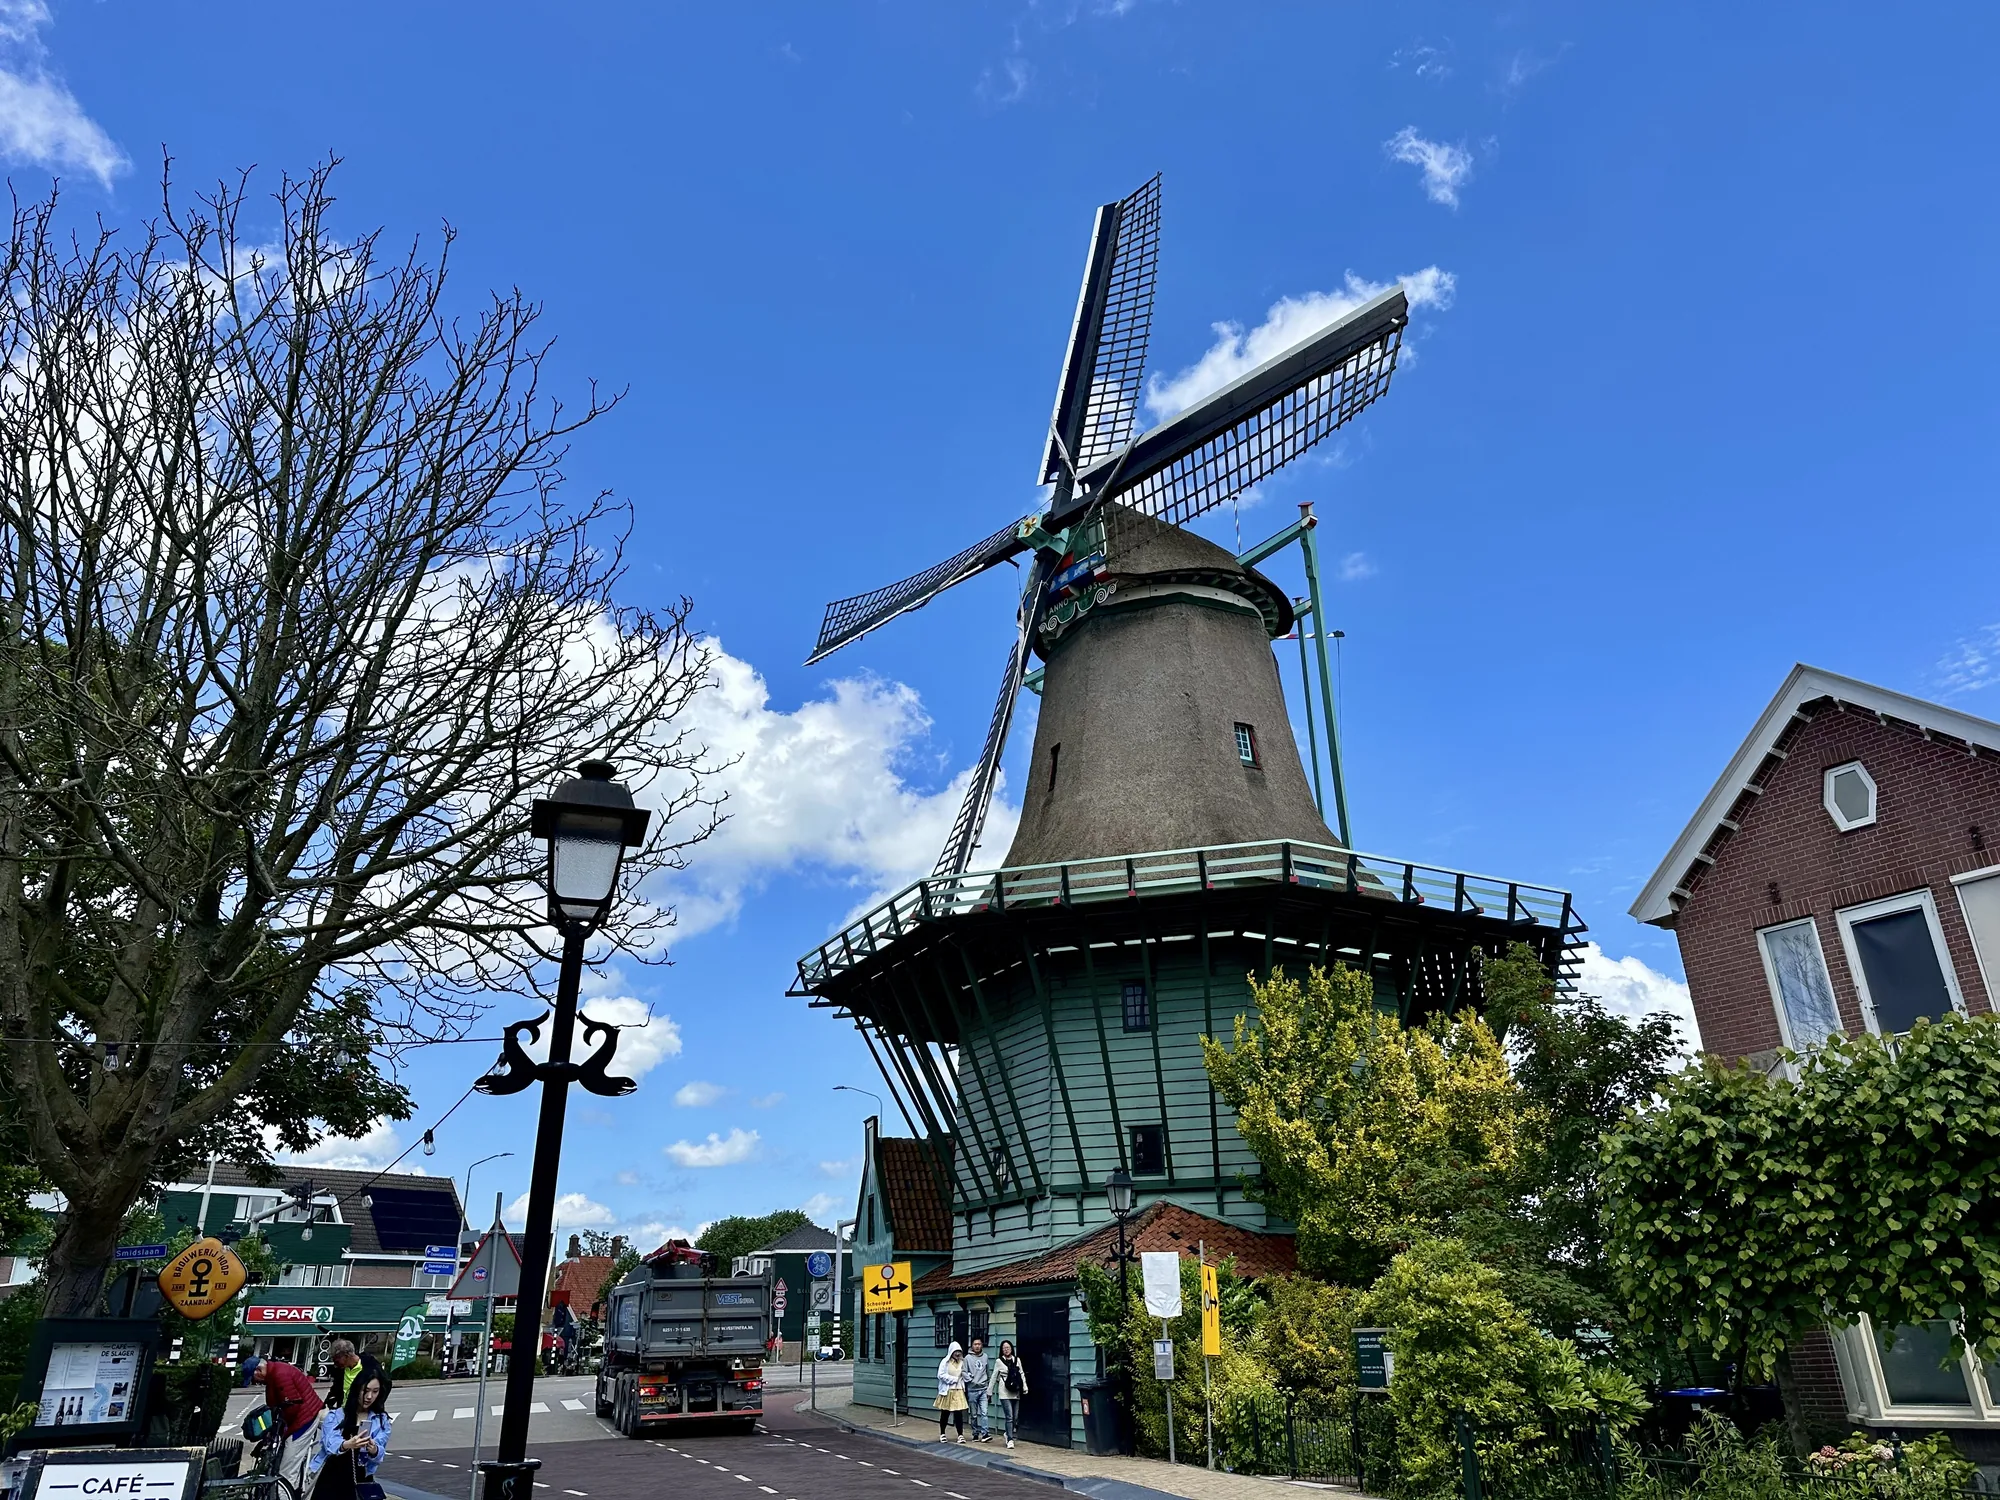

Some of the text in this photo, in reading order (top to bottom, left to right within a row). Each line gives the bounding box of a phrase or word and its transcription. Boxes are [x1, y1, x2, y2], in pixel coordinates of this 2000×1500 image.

[1048, 597, 1069, 615] ANNO
[116, 1248, 160, 1258] Smidslaan
[173, 1248, 230, 1278] BROUWERIJ HOOP
[180, 1299, 214, 1307] ZAANDIJK
[716, 1293, 742, 1304] VEST
[262, 1309, 314, 1320] SPAR
[82, 1473, 144, 1494] CAFÉ
